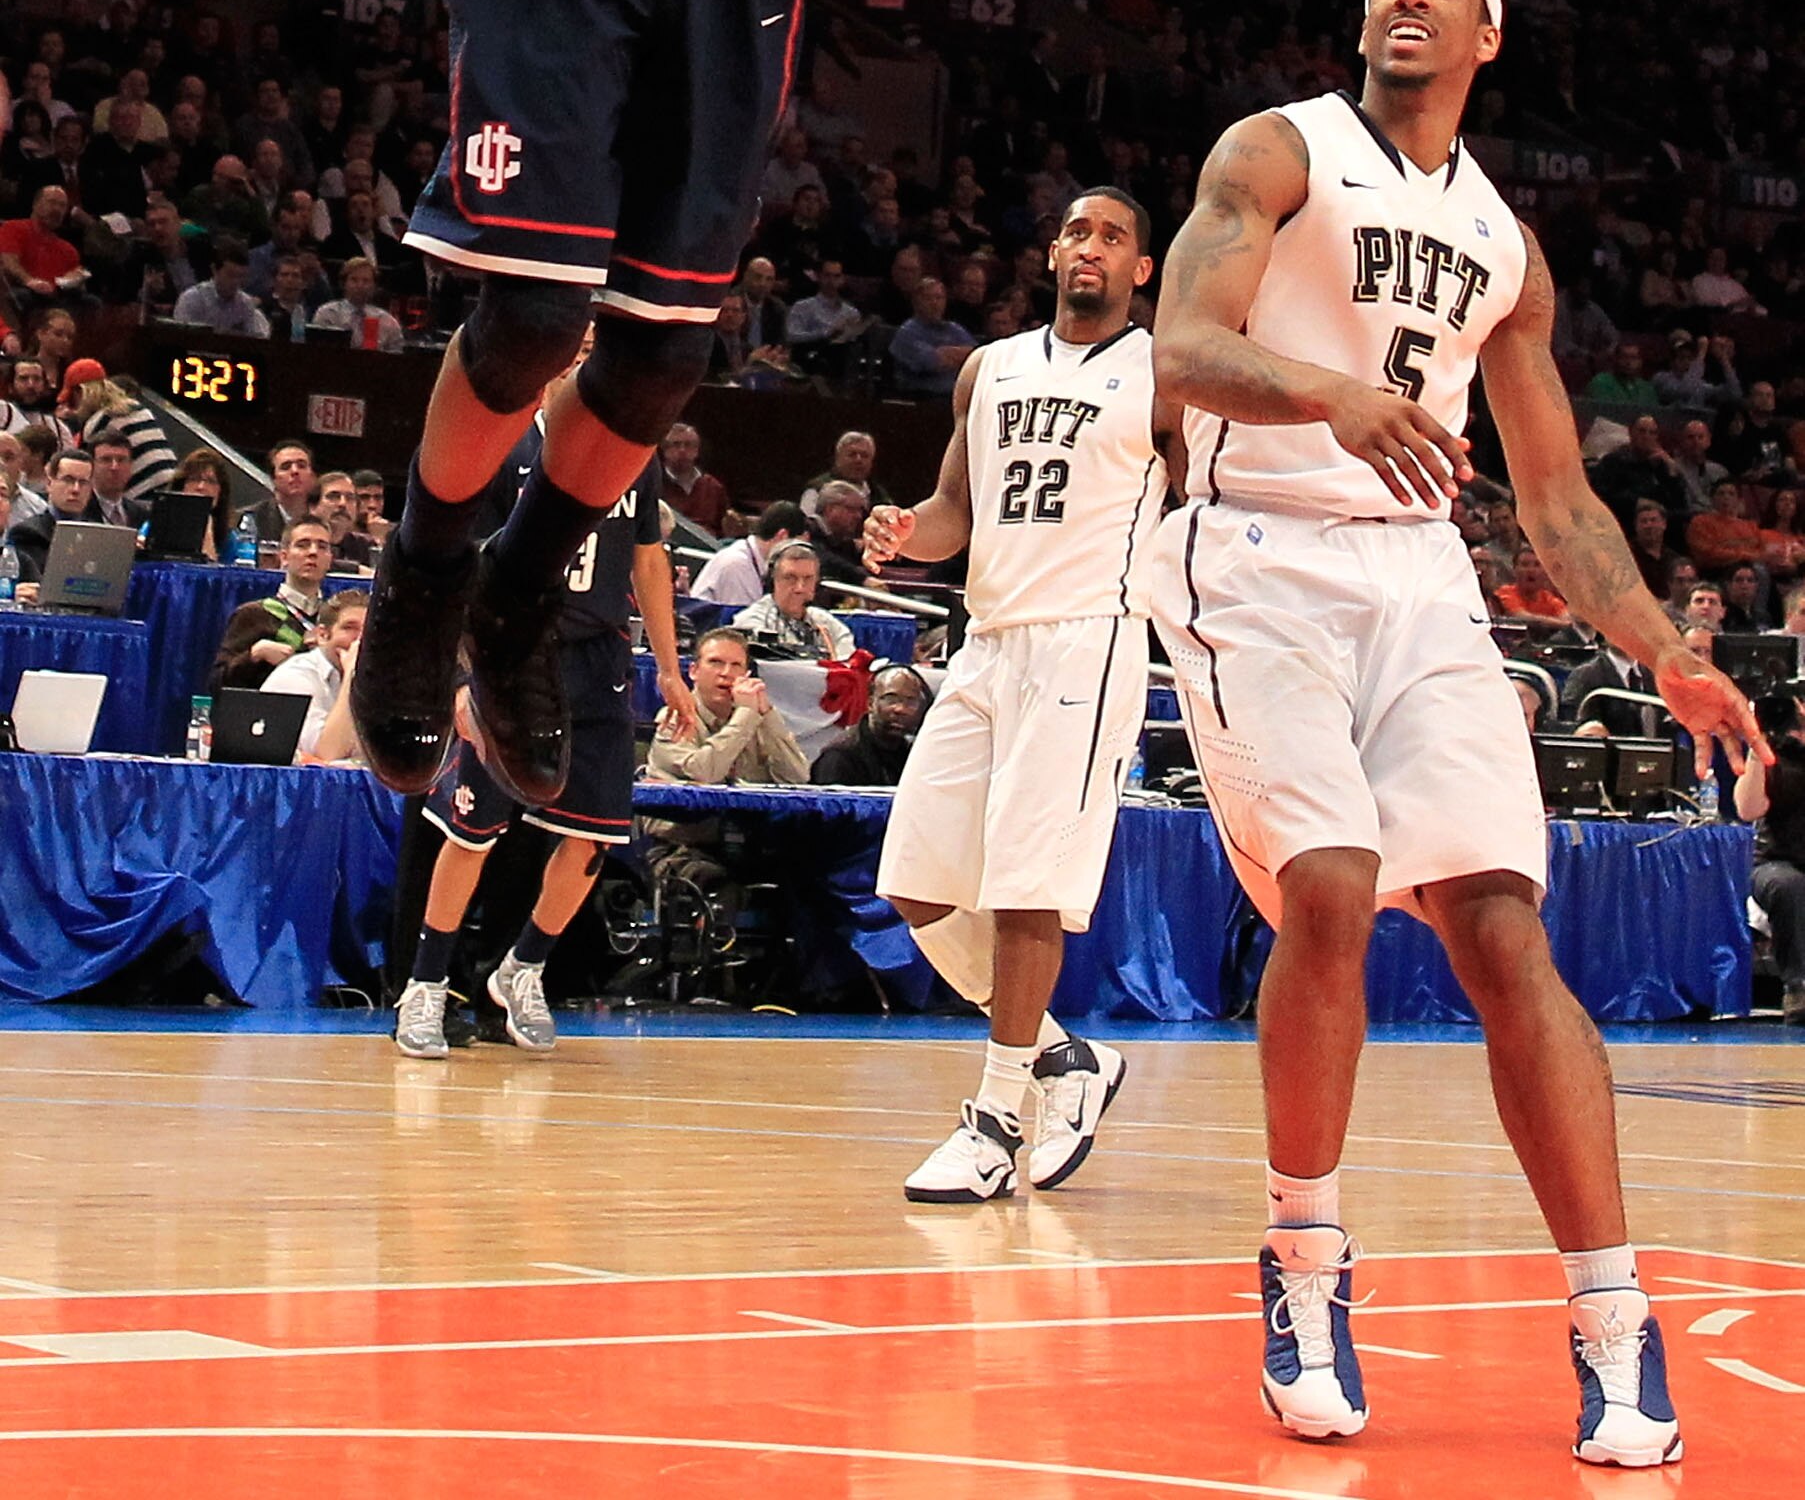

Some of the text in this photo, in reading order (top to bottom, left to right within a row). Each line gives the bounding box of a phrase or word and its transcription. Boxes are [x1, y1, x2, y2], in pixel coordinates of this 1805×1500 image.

[1353, 227, 1491, 332] PITT
[169, 354, 260, 402] 13:27
[1379, 326, 1436, 404] 5
[322, 397, 358, 432] EXIT
[997, 396, 1101, 449] PITT
[997, 458, 1071, 524] 22
